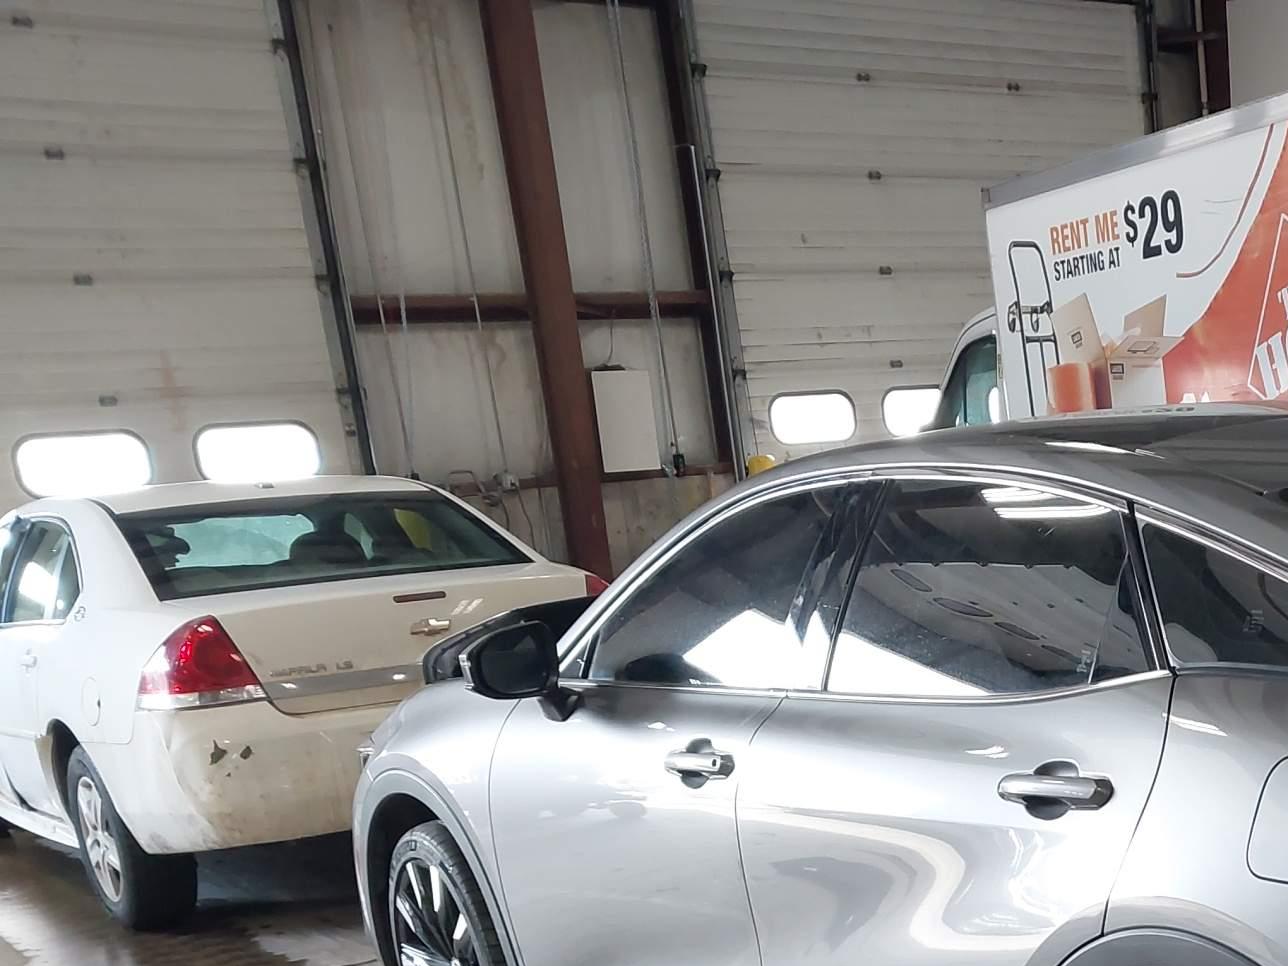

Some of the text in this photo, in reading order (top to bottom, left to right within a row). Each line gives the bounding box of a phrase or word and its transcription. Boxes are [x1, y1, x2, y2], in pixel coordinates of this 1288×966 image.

[1049, 209, 1120, 256] RENT ME
[1123, 189, 1184, 260] $29
[1053, 246, 1120, 282] STARTING AT
